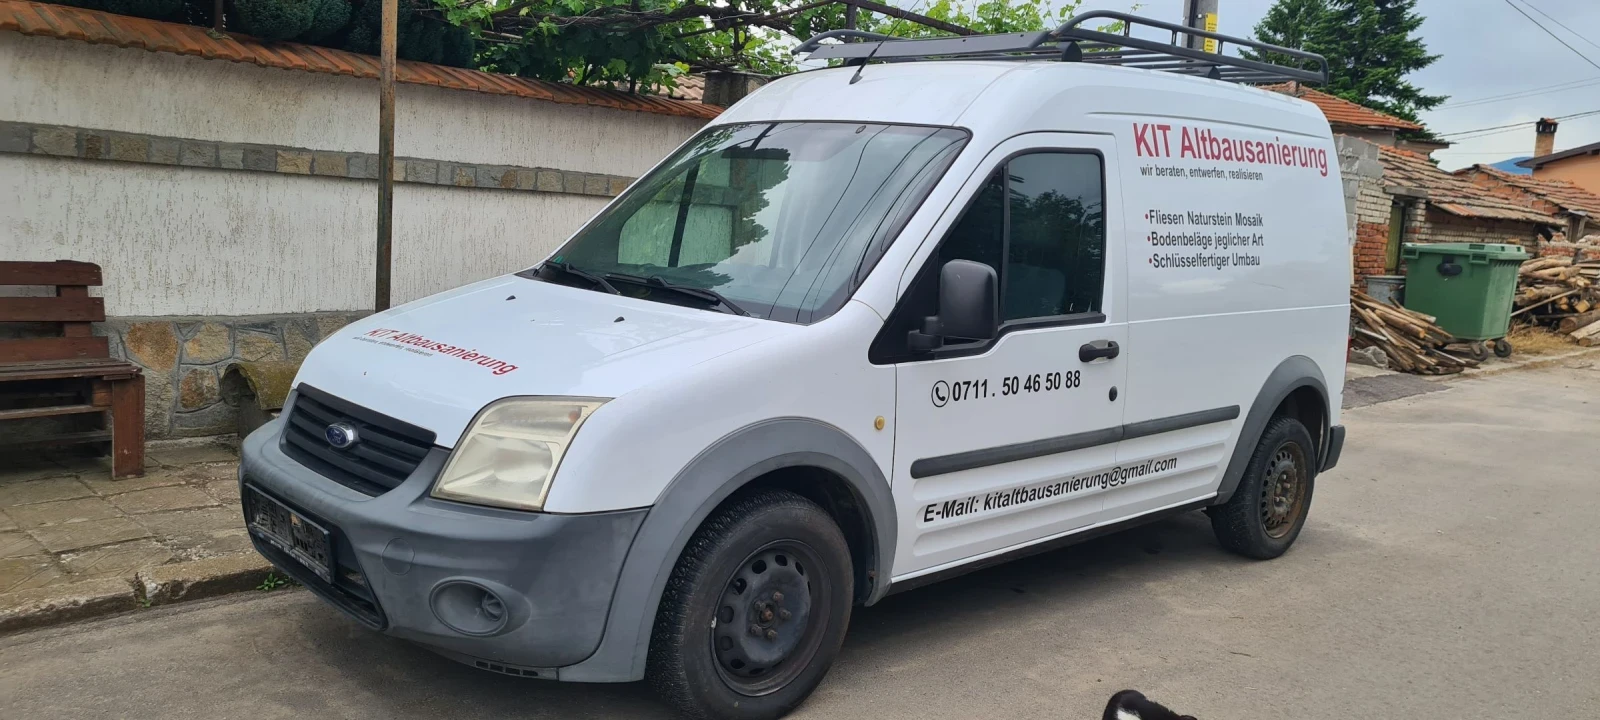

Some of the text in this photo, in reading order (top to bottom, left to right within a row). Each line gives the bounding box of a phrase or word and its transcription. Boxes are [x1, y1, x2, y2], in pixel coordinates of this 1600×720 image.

[1133, 123, 1328, 177] KIT Altbausanierung
[1140, 164, 1263, 181] wir beraten, entwerfen, realisieren
[1149, 209, 1184, 225] Fliesen
[1187, 210, 1232, 226] Naturstein
[1151, 231, 1264, 249] Bodenbeläge jeglicher Art
[1153, 252, 1260, 270] Schlüsselfertiger Umbau
[364, 328, 399, 338] KIT
[386, 332, 518, 375] Altbausanierung
[1002, 376, 1020, 396] 50
[1024, 374, 1041, 393] 46
[1045, 371, 1061, 391] 50
[1065, 370, 1081, 389] 88
[923, 457, 1178, 523] E-Mail: kitaltbausanierung@gmail.com
